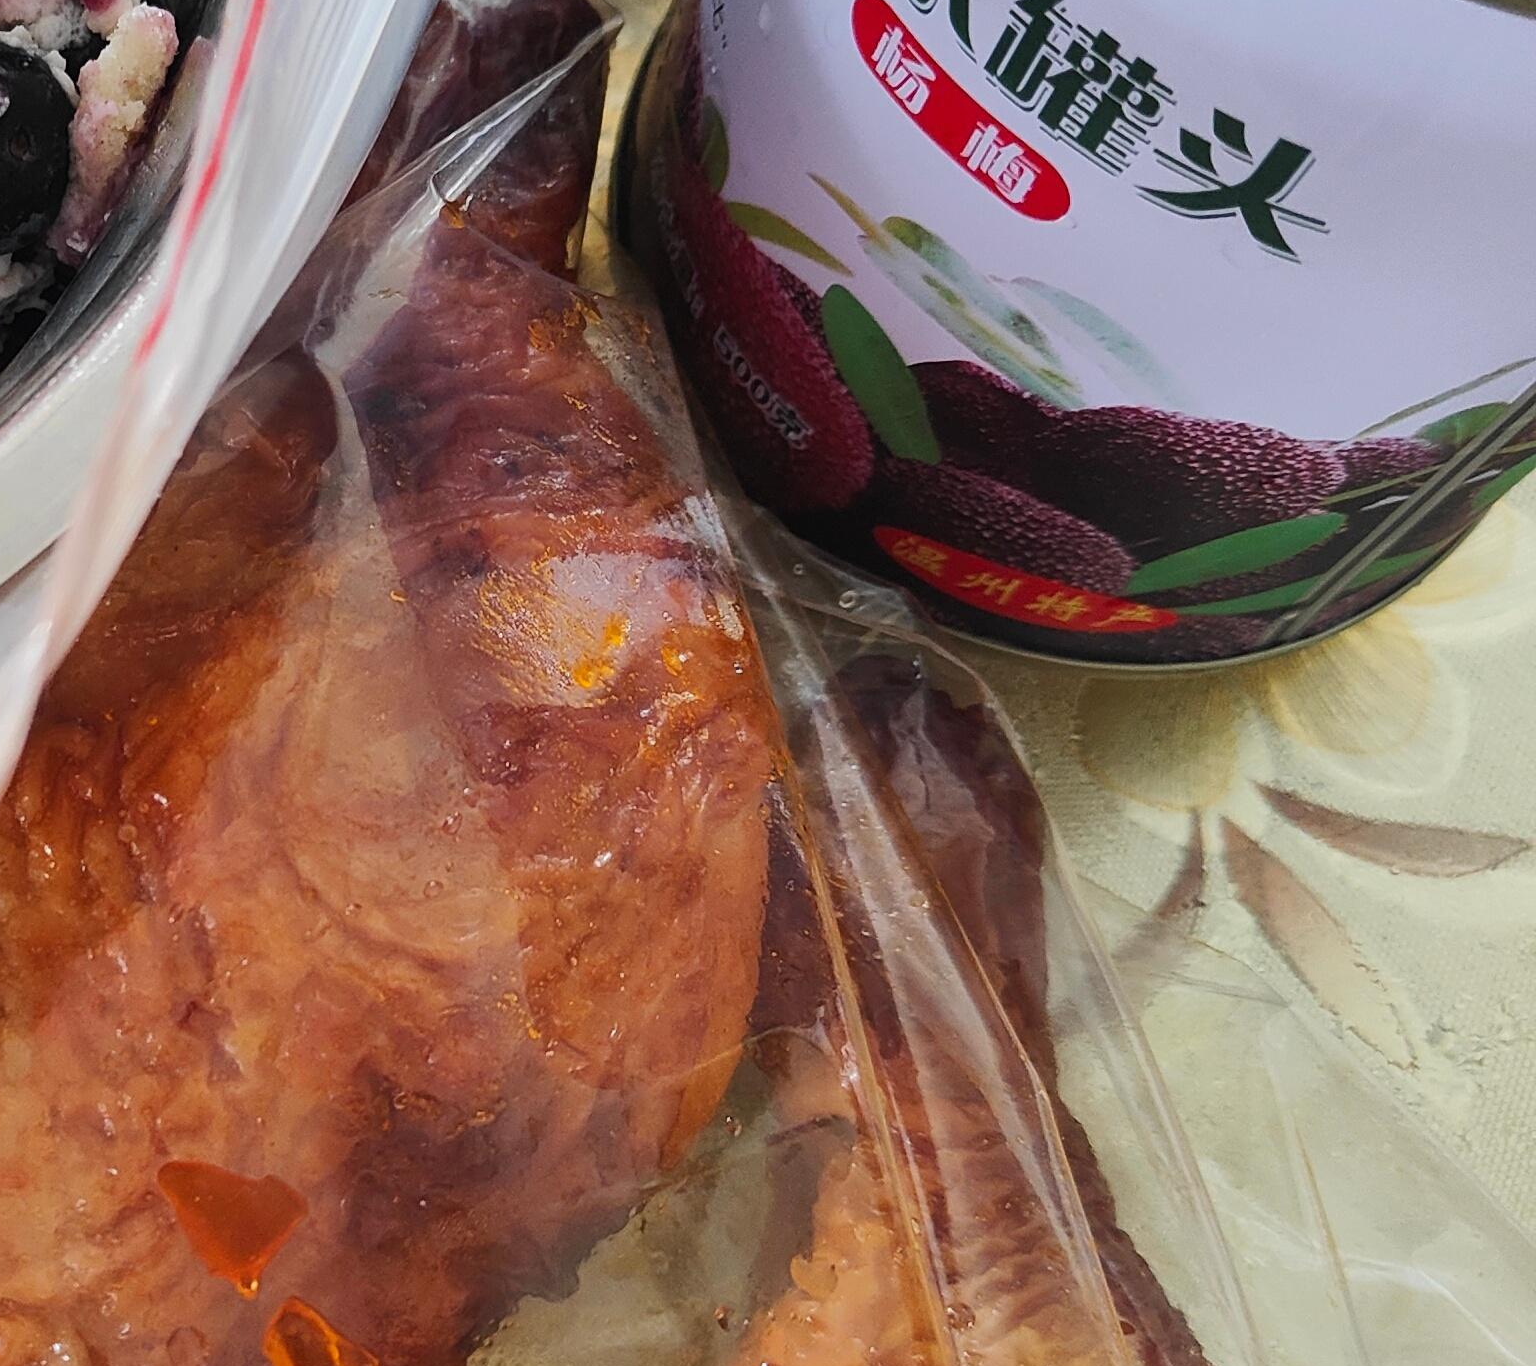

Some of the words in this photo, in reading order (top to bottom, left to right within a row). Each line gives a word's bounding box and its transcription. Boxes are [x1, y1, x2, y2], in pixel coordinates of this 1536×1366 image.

[870, 26, 1039, 207] 杨梅
[713, 324, 814, 451] 500克
[890, 535, 1155, 629] 温州特产
